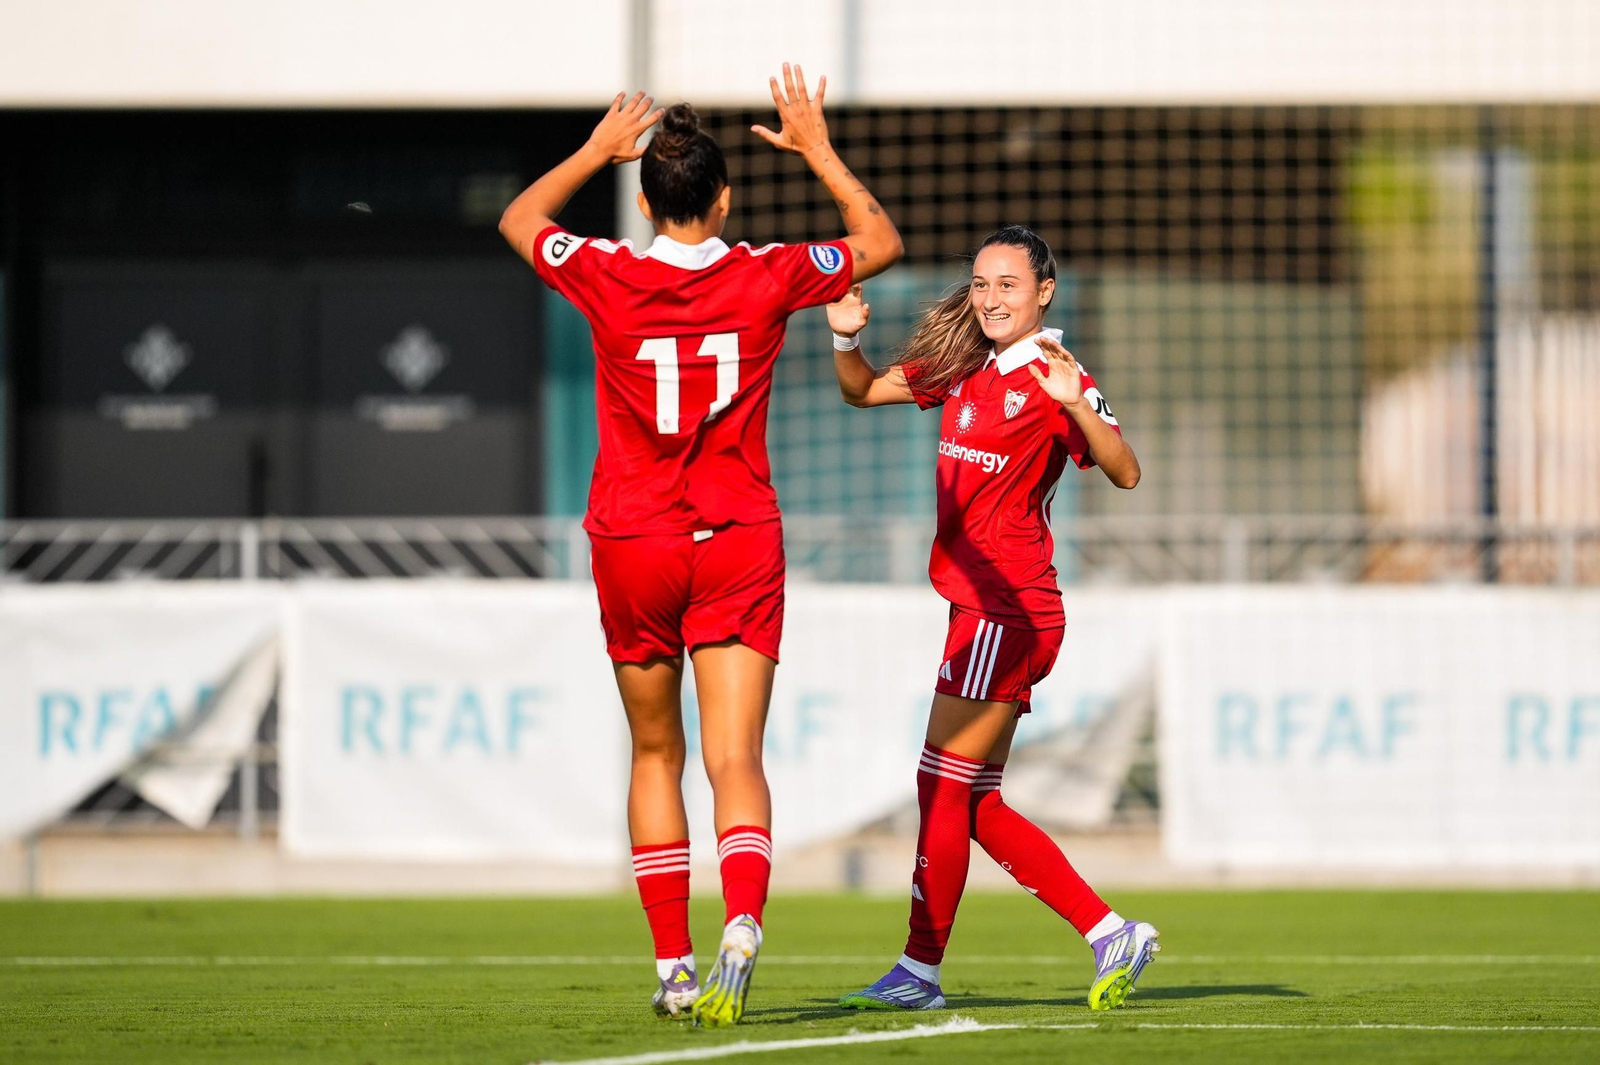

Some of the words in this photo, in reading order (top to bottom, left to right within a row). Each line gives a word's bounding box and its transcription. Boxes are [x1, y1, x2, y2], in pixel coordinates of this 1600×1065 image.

[635, 332, 740, 434] 11
[938, 436, 1010, 474] cialenergy
[37, 684, 217, 760] RFA
[338, 682, 548, 755] RFAF
[1213, 689, 1418, 760] RFAF
